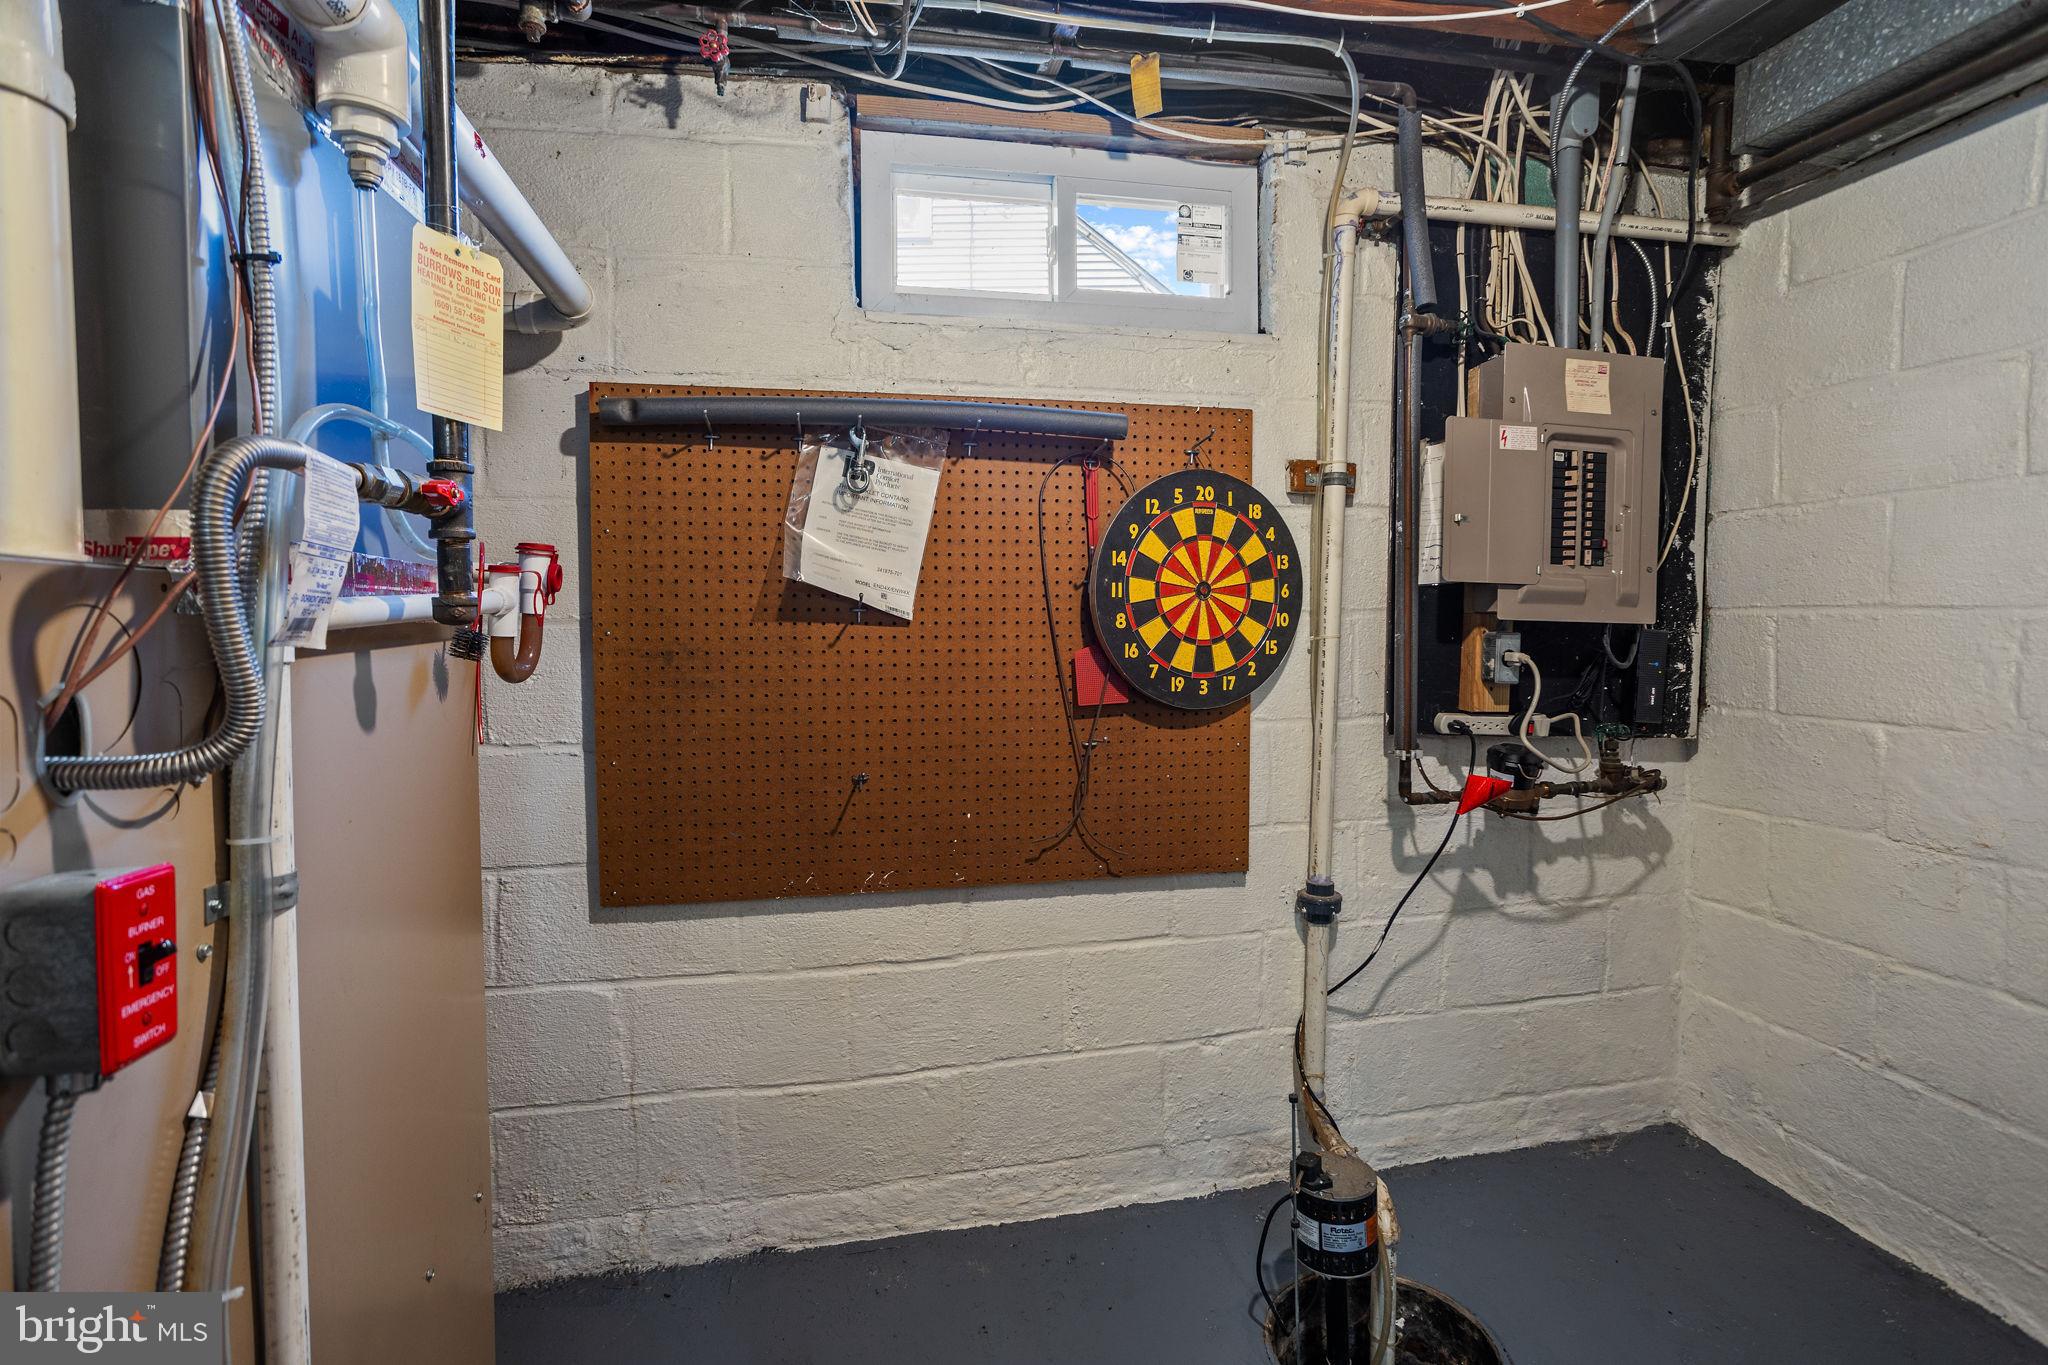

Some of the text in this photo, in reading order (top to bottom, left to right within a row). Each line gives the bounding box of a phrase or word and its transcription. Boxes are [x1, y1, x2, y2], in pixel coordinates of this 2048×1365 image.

[419, 242, 501, 284] Do Not Remove This Card
[417, 253, 501, 297] BURROWS and SON
[417, 266, 446, 286] HEATING
[448, 280, 454, 289] &
[456, 282, 486, 301] COOLING
[488, 296, 501, 307] LLC
[876, 473, 900, 484] Comfort
[877, 466, 914, 481] International
[874, 479, 901, 490] Products
[880, 491, 911, 503] CONTAINS
[1174, 488, 1184, 504] 5
[1195, 486, 1215, 501] 20
[1227, 491, 1233, 507] 1
[869, 497, 909, 511] INFORMATION
[1146, 499, 1161, 515] 12
[1248, 504, 1262, 519] 18
[1129, 524, 1139, 539] 9
[1265, 527, 1275, 542] 4
[1111, 551, 1127, 567] 14
[1276, 554, 1289, 570] 13
[1111, 582, 1123, 599] 11
[1280, 583, 1290, 598] 6
[1115, 613, 1127, 629] 8
[1276, 612, 1289, 627] 10
[1124, 642, 1139, 659] 16
[1265, 640, 1278, 656] 15
[1149, 664, 1159, 679] 7
[1248, 661, 1257, 677] 2
[1170, 676, 1185, 693] 19
[1199, 680, 1209, 695] 3
[1222, 675, 1236, 691] 17
[136, 884, 156, 900] GAS
[127, 915, 165, 938] BURNER
[124, 951, 136, 964] ON
[155, 961, 171, 977] OFF
[121, 984, 175, 1019] EMERGENCY
[133, 1023, 166, 1048] SWITCH
